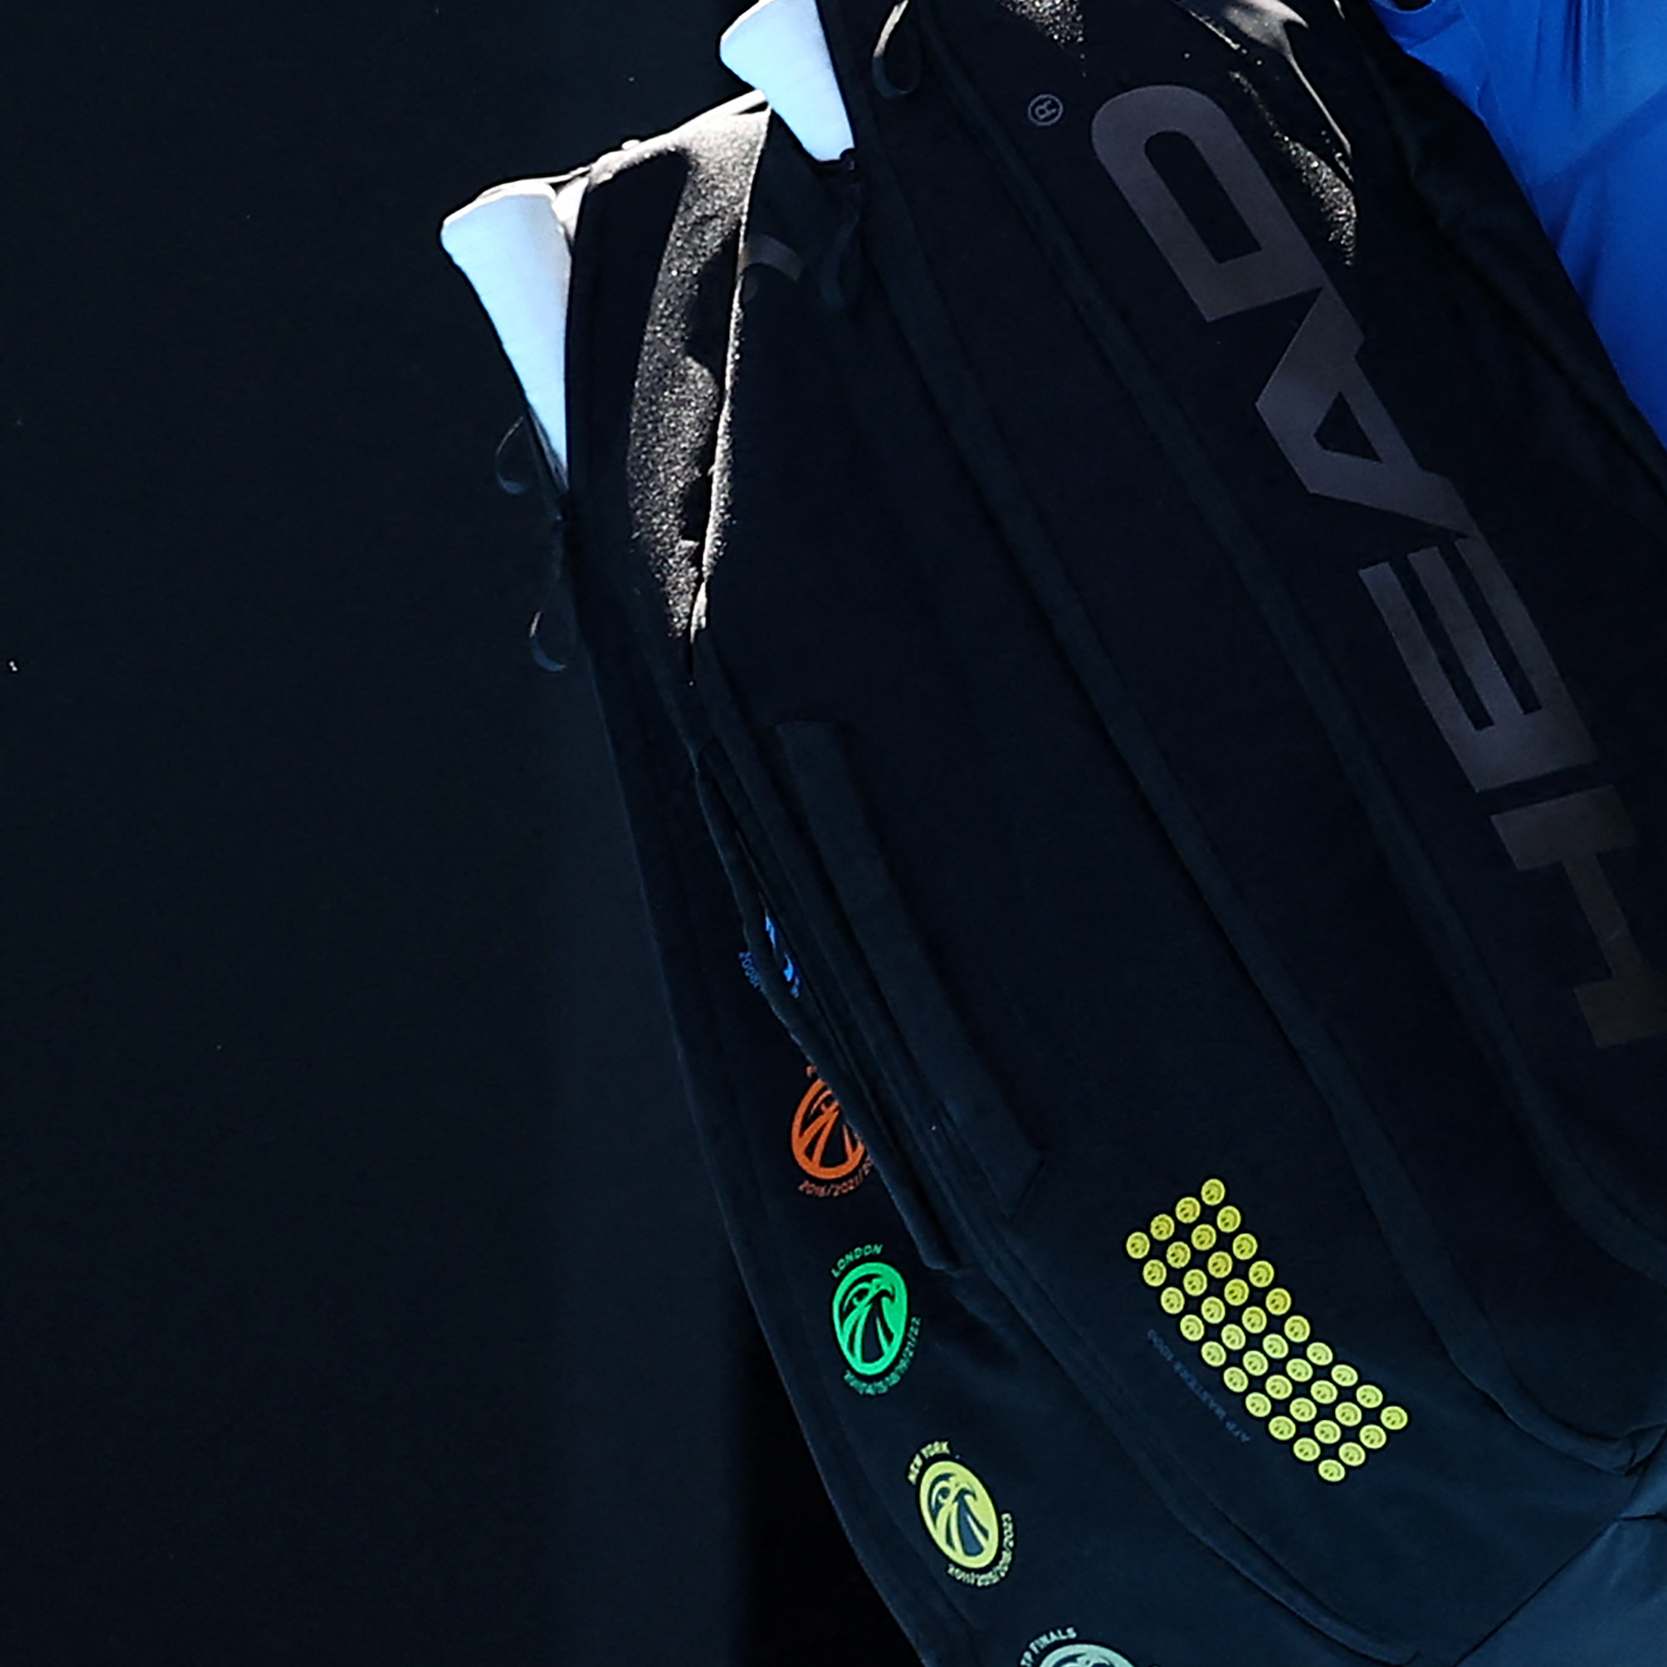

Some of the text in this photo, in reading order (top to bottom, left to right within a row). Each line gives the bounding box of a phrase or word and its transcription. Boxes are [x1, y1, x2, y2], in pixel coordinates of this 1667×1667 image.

[830, 1242, 884, 1278] LONDON
[906, 1440, 950, 1485] NEW YORK
[1029, 1626, 1077, 1654] FINALS
